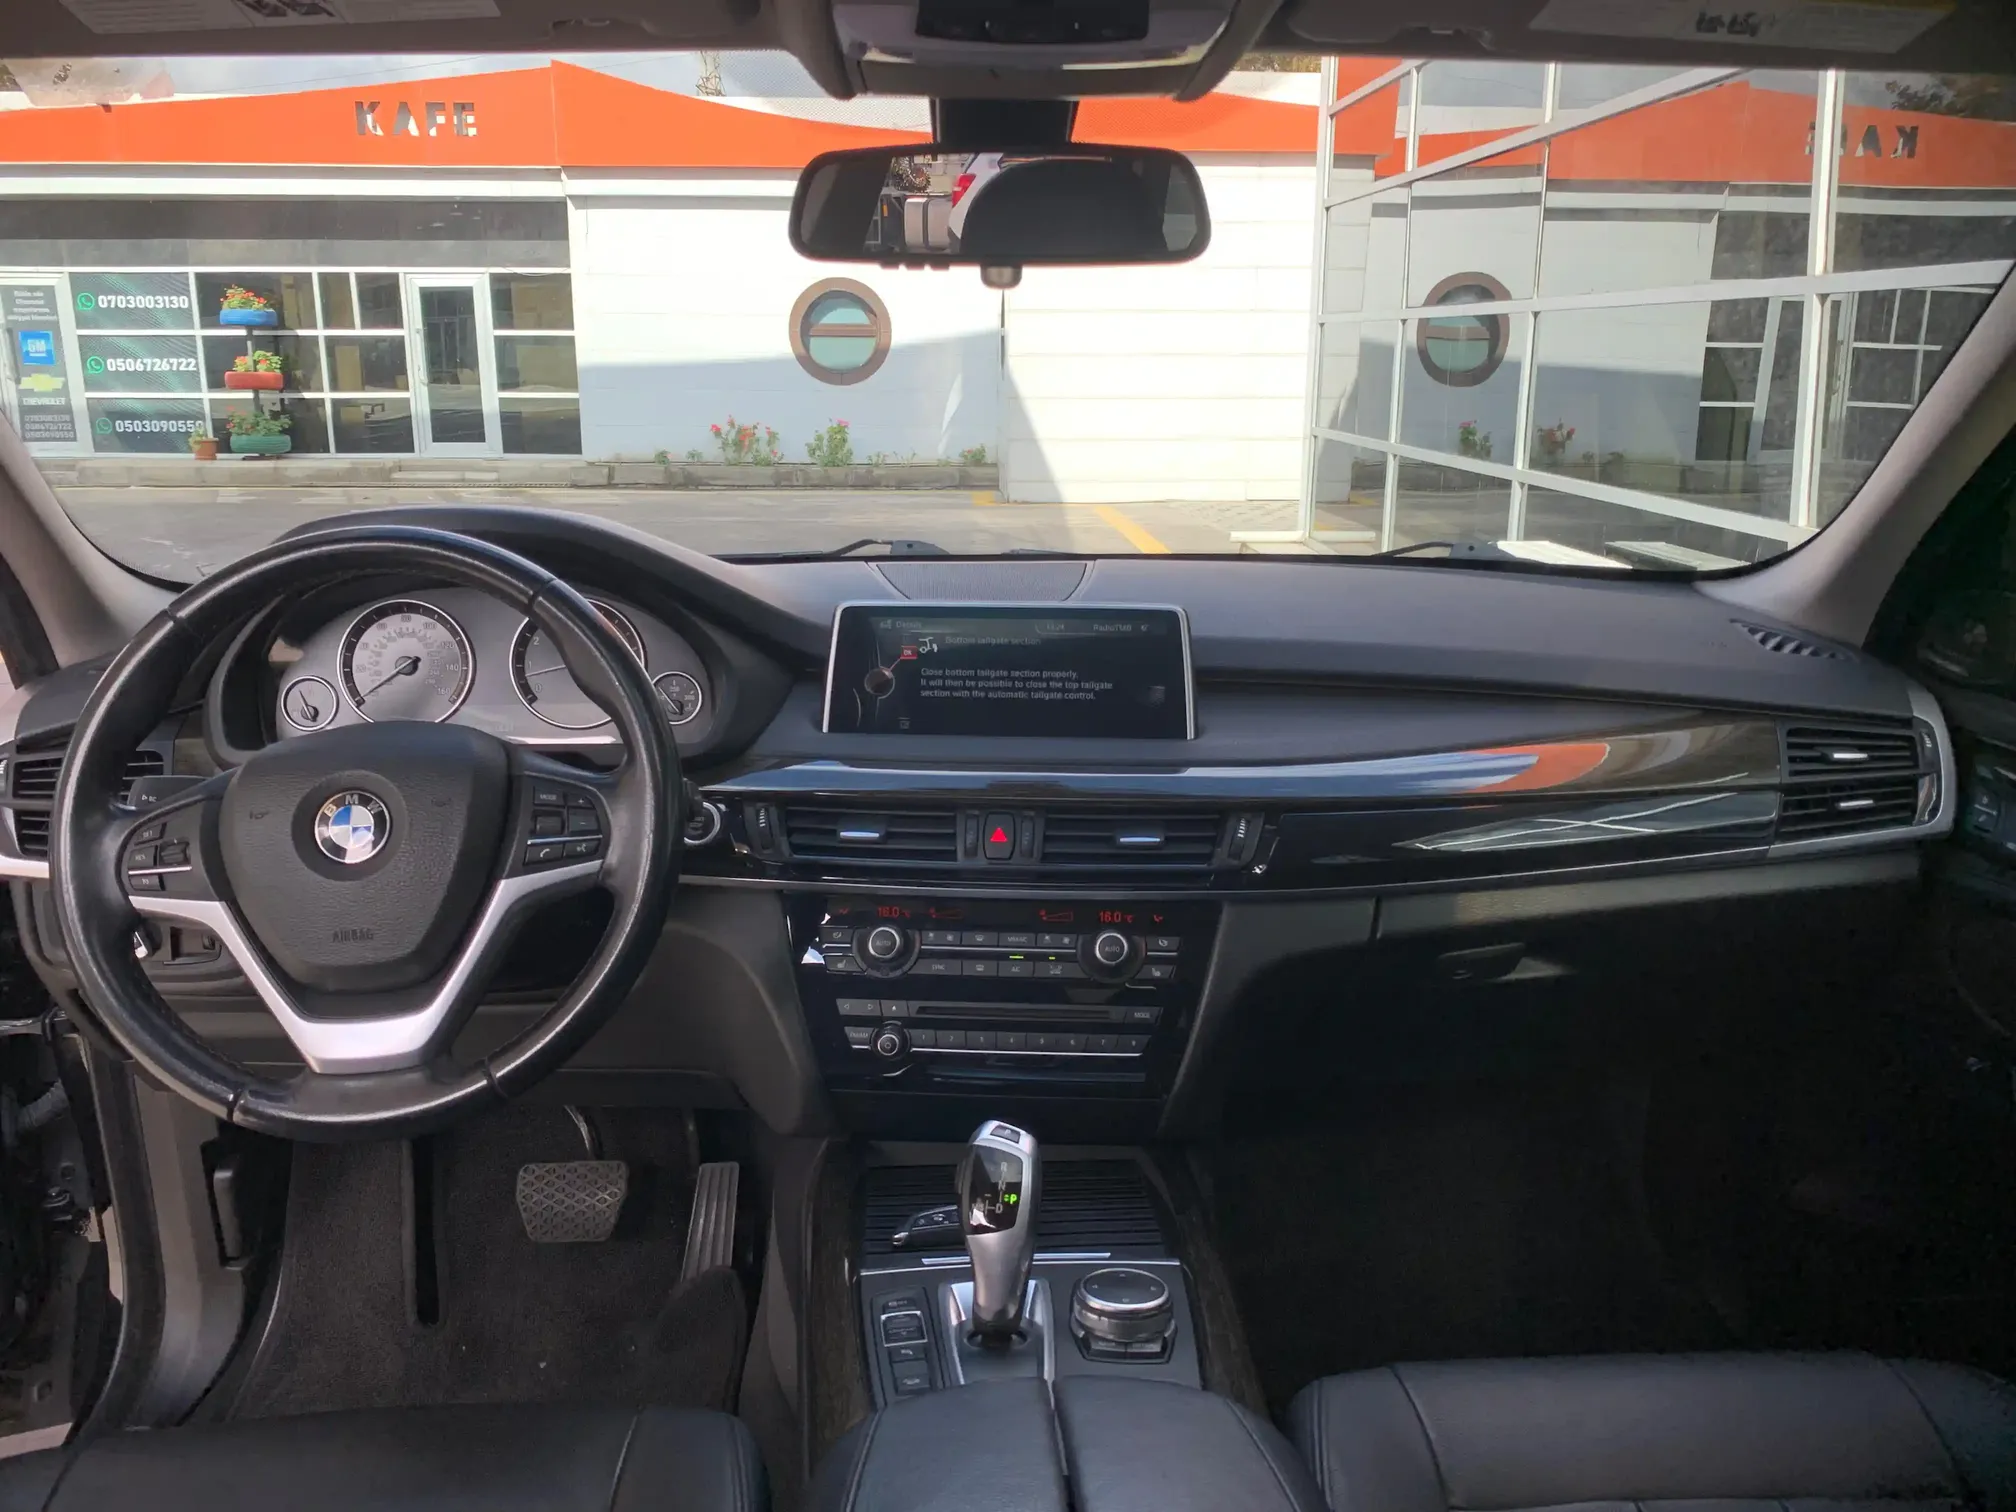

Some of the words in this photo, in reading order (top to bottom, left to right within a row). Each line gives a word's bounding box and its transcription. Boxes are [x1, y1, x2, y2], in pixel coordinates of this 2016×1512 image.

[355, 101, 477, 137] KAFE
[97, 295, 189, 309] 0703003130
[106, 358, 197, 372] 0506726722
[533, 637, 540, 646] 2
[446, 663, 459, 671] 140
[921, 668, 944, 677] Close
[945, 668, 976, 677] bottom
[977, 669, 1009, 679] tailgate
[1010, 670, 1041, 678] section
[438, 686, 451, 694] 160
[535, 684, 542, 692] 0
[928, 679, 943, 687] will
[945, 679, 964, 687] then
[965, 680, 977, 688] be
[978, 680, 1013, 689] possible
[1014, 680, 1024, 688] to
[1025, 681, 1047, 689] close
[1049, 681, 1063, 689] the
[1065, 682, 1079, 690] top
[1081, 681, 1113, 691] tailgate
[920, 690, 951, 698] section
[952, 690, 970, 698] with
[972, 690, 986, 698] the
[988, 690, 1029, 699] automatic
[1030, 691, 1063, 700] tailgate
[1064, 692, 1096, 700] control.
[323, 794, 383, 817] BMW
[1099, 911, 1121, 923] 16.0
[332, 928, 374, 943] AIRBAG
[1105, 945, 1120, 953] AUTO
[1010, 1194, 1018, 1205] P
[995, 1203, 1003, 1213] D
